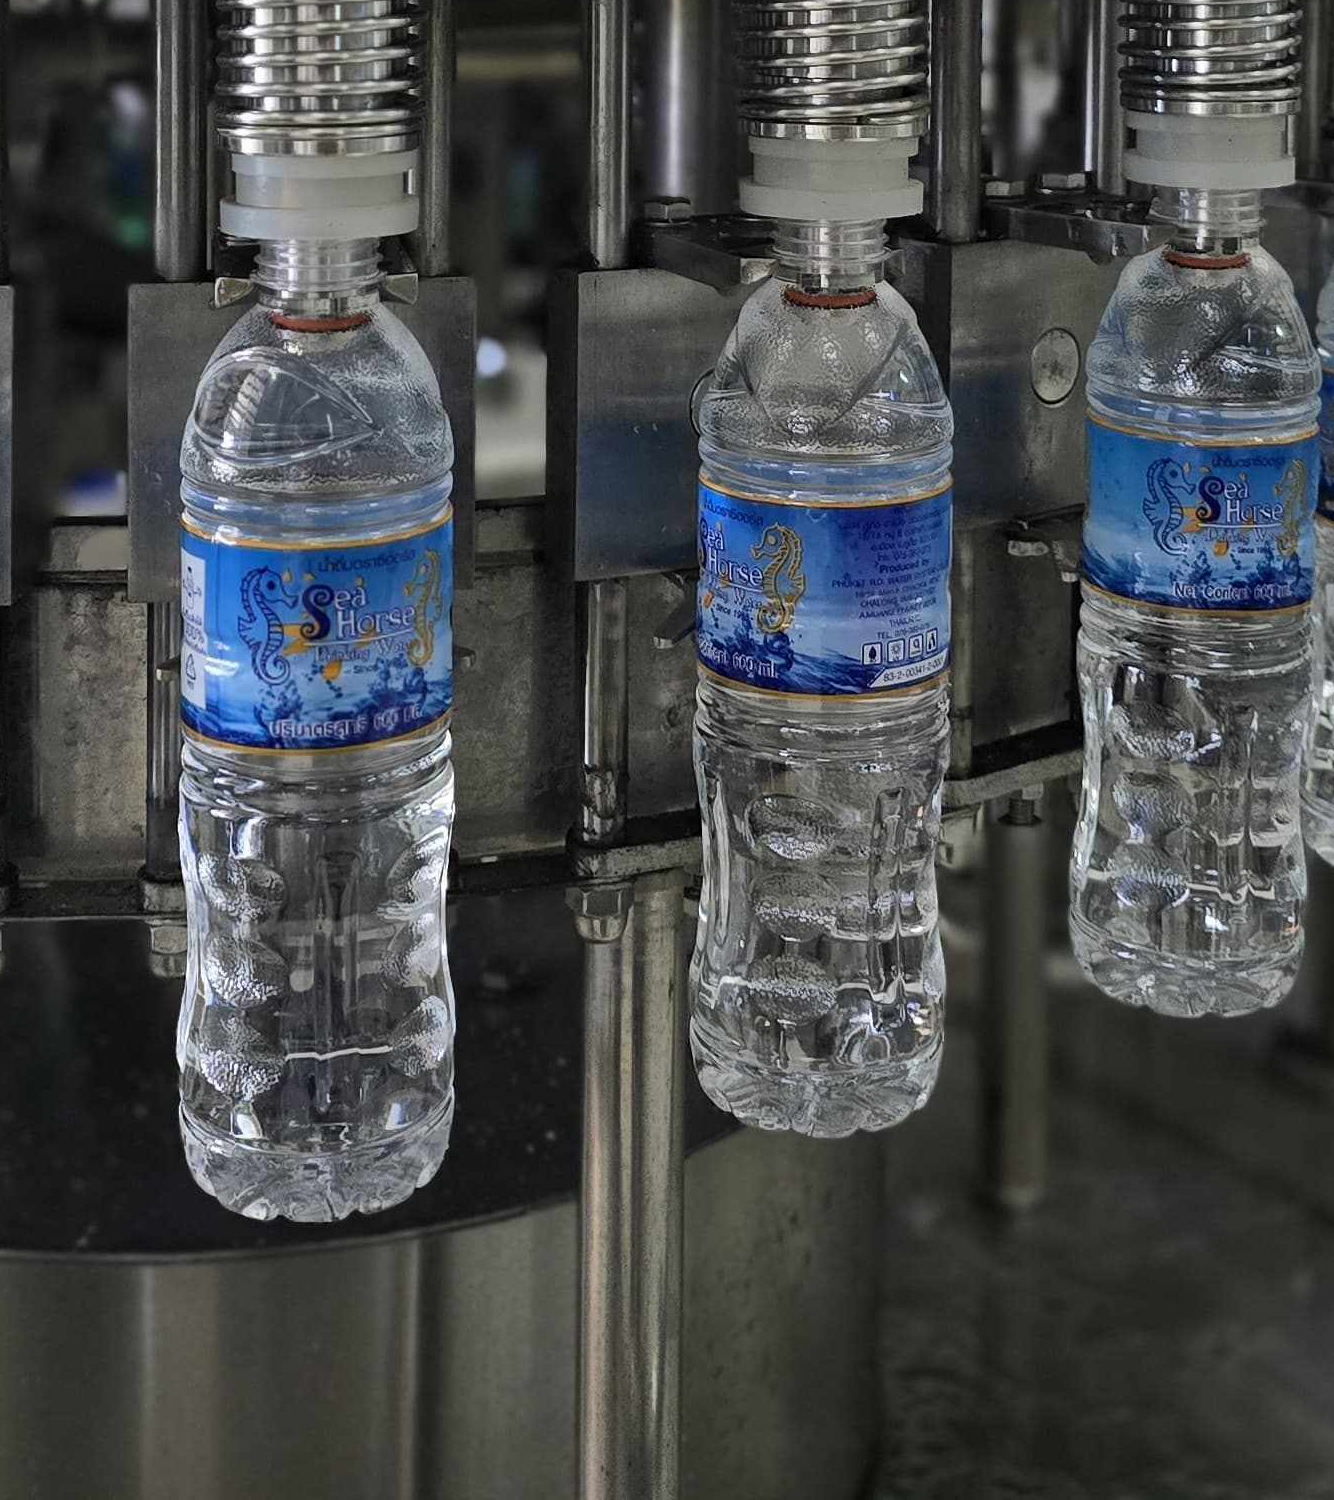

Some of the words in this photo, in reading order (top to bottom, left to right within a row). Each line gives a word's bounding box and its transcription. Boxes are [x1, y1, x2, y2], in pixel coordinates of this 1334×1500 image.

[1195, 474, 1250, 524] Sea
[1226, 499, 1283, 523] Horse
[708, 549, 764, 587] Horse
[879, 560, 919, 574] Produced
[1173, 581, 1196, 599] Net
[299, 584, 367, 641] Sea
[337, 606, 416, 638] Horse
[732, 652, 754, 673] 600
